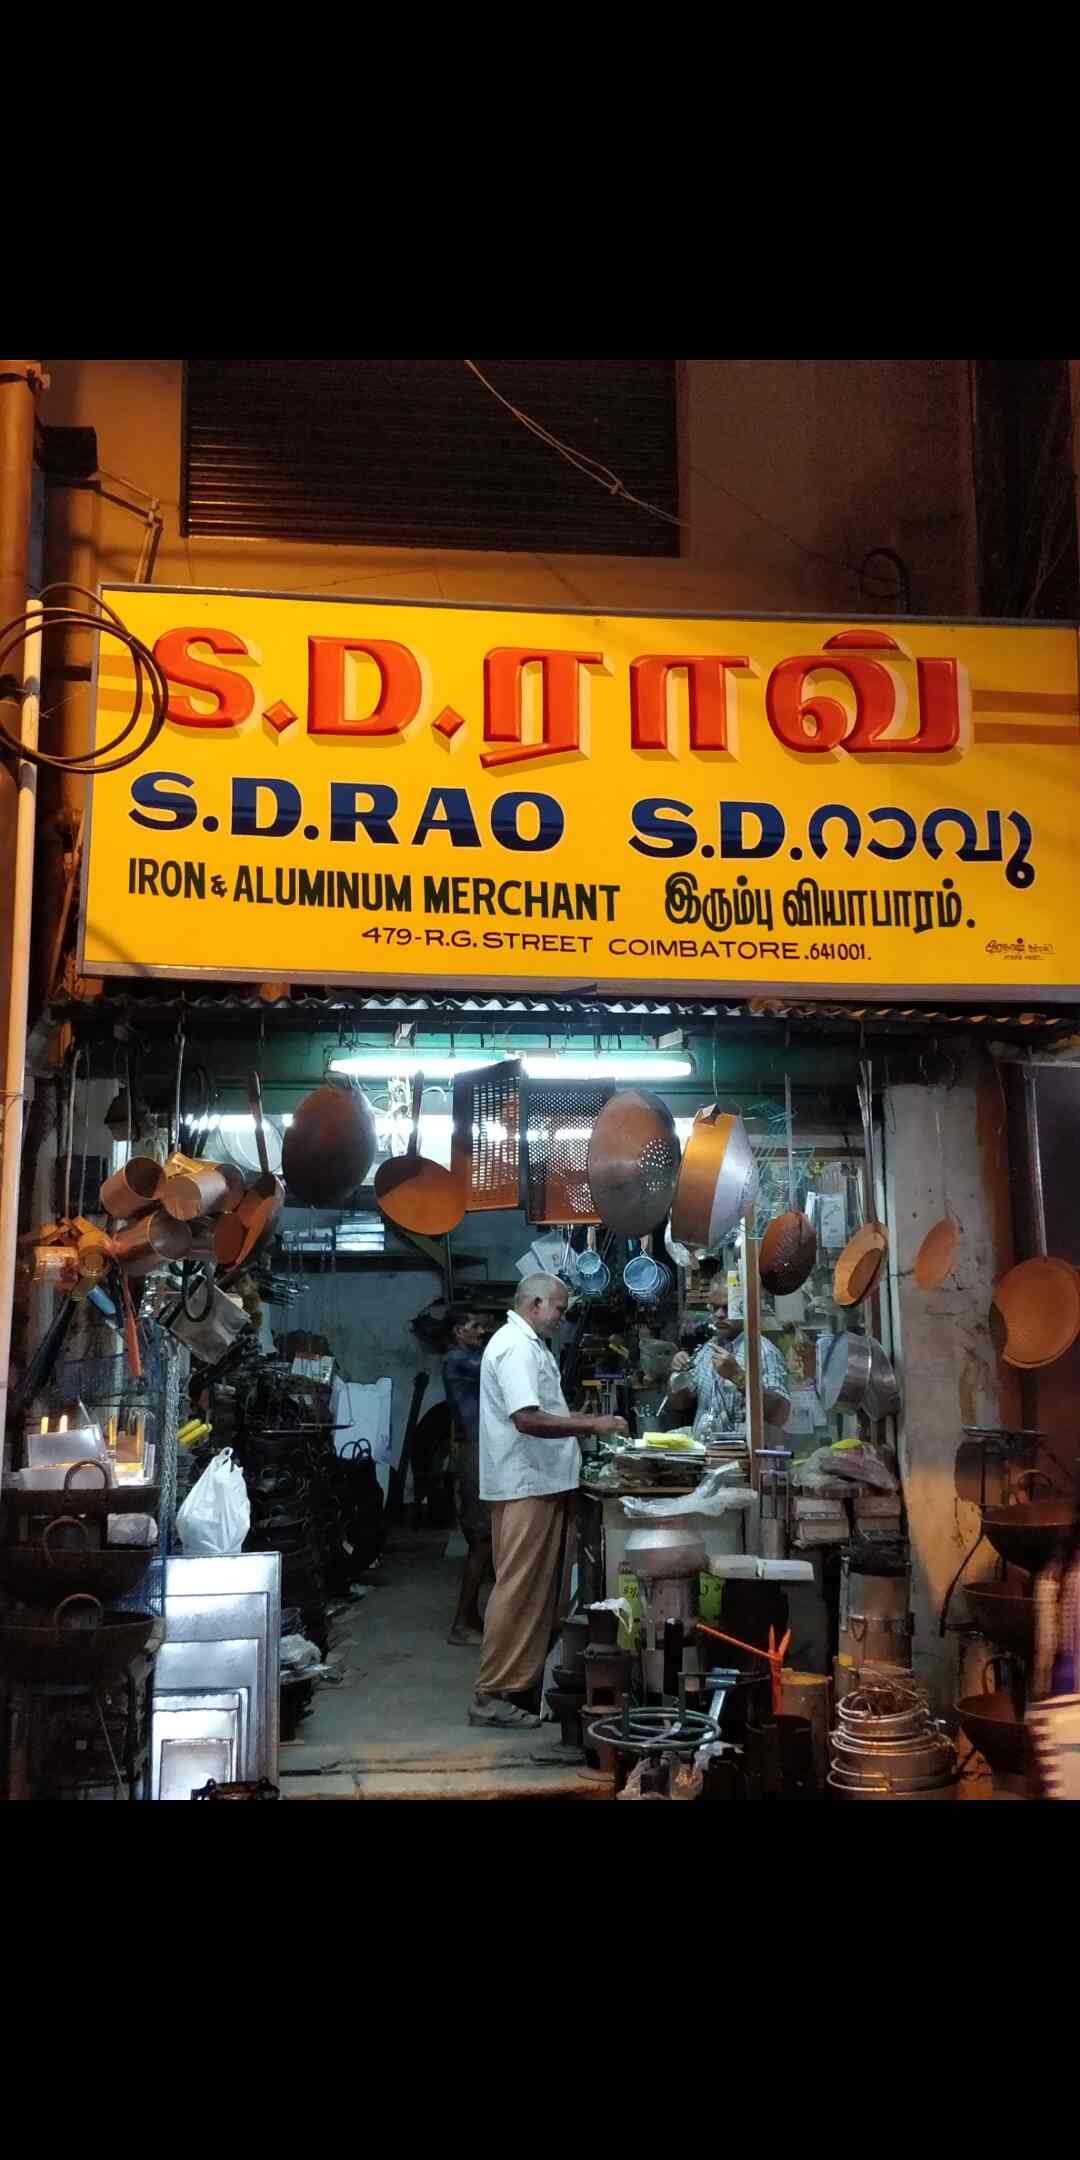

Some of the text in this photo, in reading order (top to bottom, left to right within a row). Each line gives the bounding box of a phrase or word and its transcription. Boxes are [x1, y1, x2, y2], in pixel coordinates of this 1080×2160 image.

[128, 771, 565, 852] S.D.RAO
[128, 858, 621, 922] IRON & ALUMINUM MERCHANT
[664, 871, 774, 932] இரும்பு
